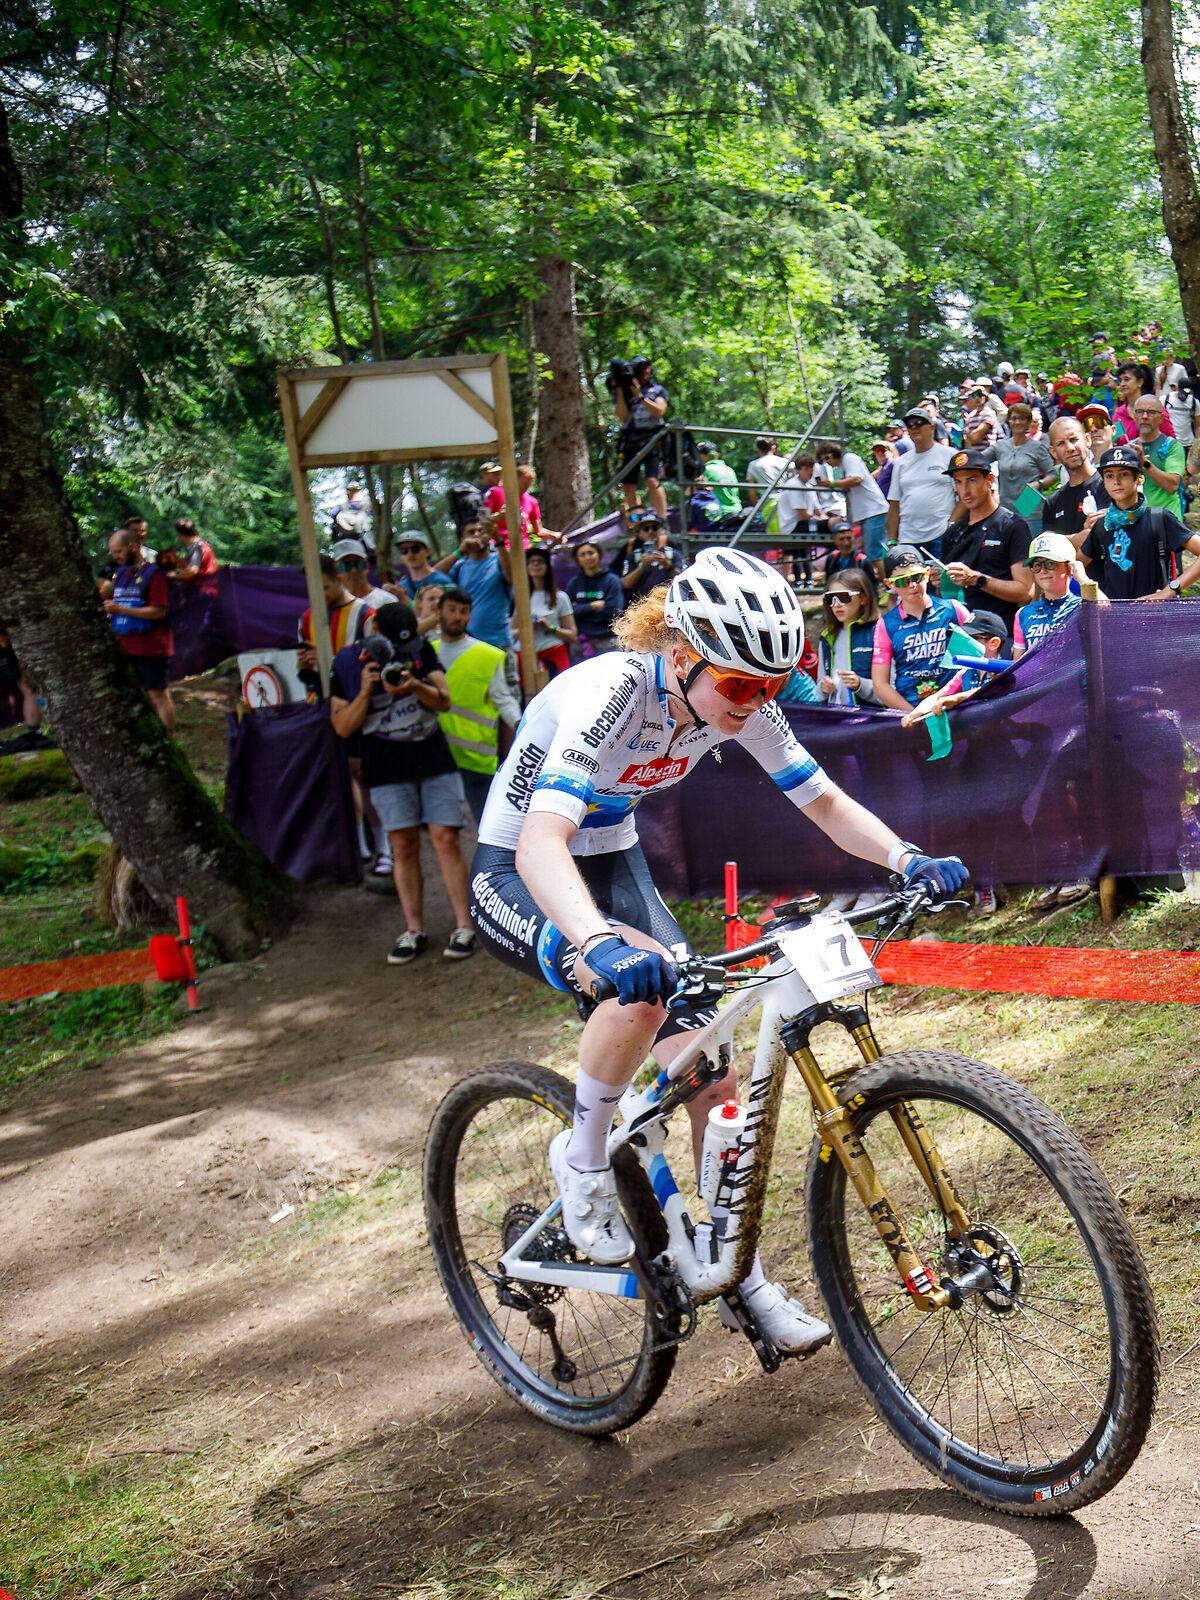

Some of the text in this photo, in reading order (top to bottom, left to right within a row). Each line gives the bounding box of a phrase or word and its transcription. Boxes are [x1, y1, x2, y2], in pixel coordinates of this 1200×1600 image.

[676, 607, 710, 660] CANYON
[903, 627, 947, 650] SANTA
[905, 641, 946, 662] MARIA
[580, 672, 638, 749] deceuninck
[759, 706, 789, 737] OOSTER
[567, 751, 598, 771] ABUS
[640, 740, 661, 750] UEC
[505, 743, 546, 812] Alpecin
[629, 760, 682, 780] Alpecin
[471, 871, 538, 947] deceuninck
[477, 913, 516, 953] WINDOWS
[868, 1197, 913, 1266] FOX
